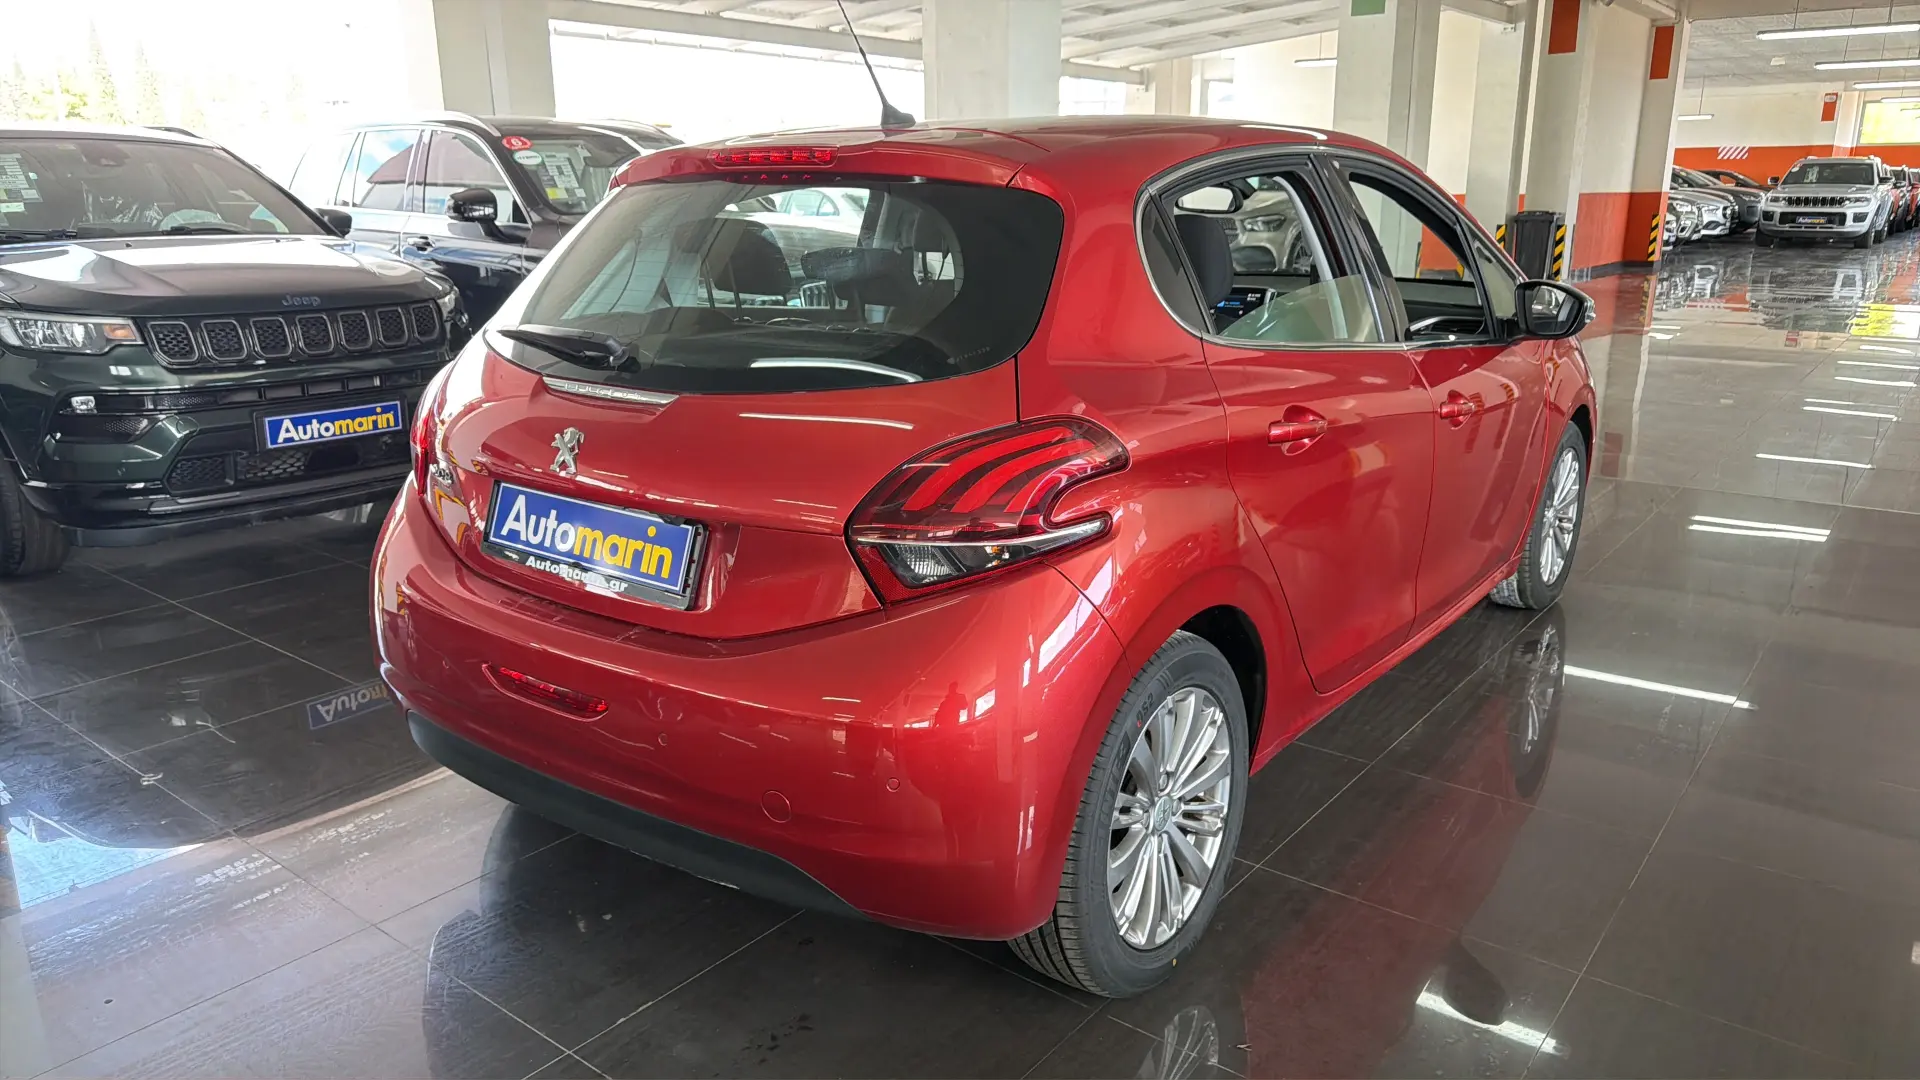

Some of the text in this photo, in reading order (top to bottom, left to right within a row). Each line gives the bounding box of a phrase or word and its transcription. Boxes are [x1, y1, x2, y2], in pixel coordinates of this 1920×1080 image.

[281, 294, 321, 307] Jeep
[277, 407, 395, 444] Automarin
[500, 494, 673, 579] Automarin
